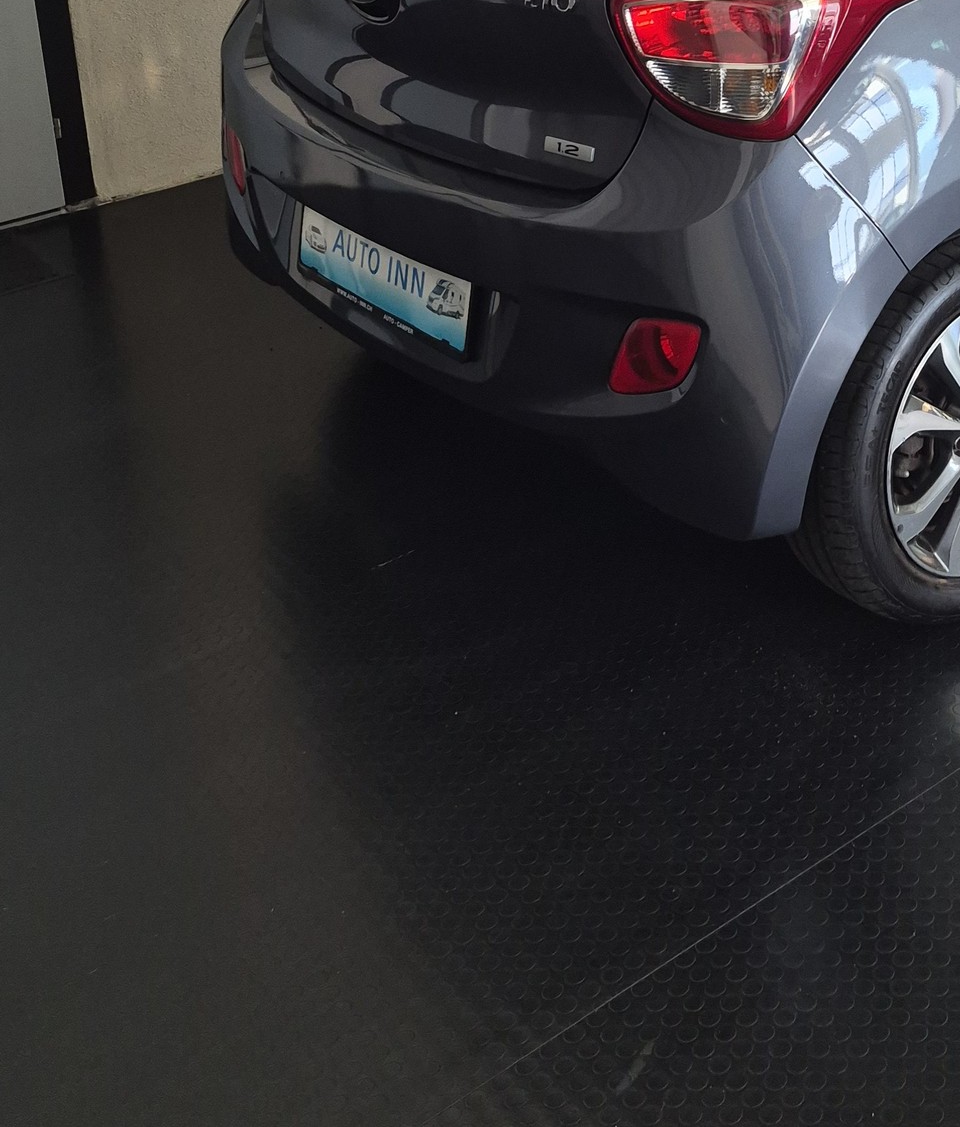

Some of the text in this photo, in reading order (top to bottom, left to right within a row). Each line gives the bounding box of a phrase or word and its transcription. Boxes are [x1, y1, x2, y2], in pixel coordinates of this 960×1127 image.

[557, 142, 579, 157] 1.2
[332, 229, 425, 298] AUTO INN
